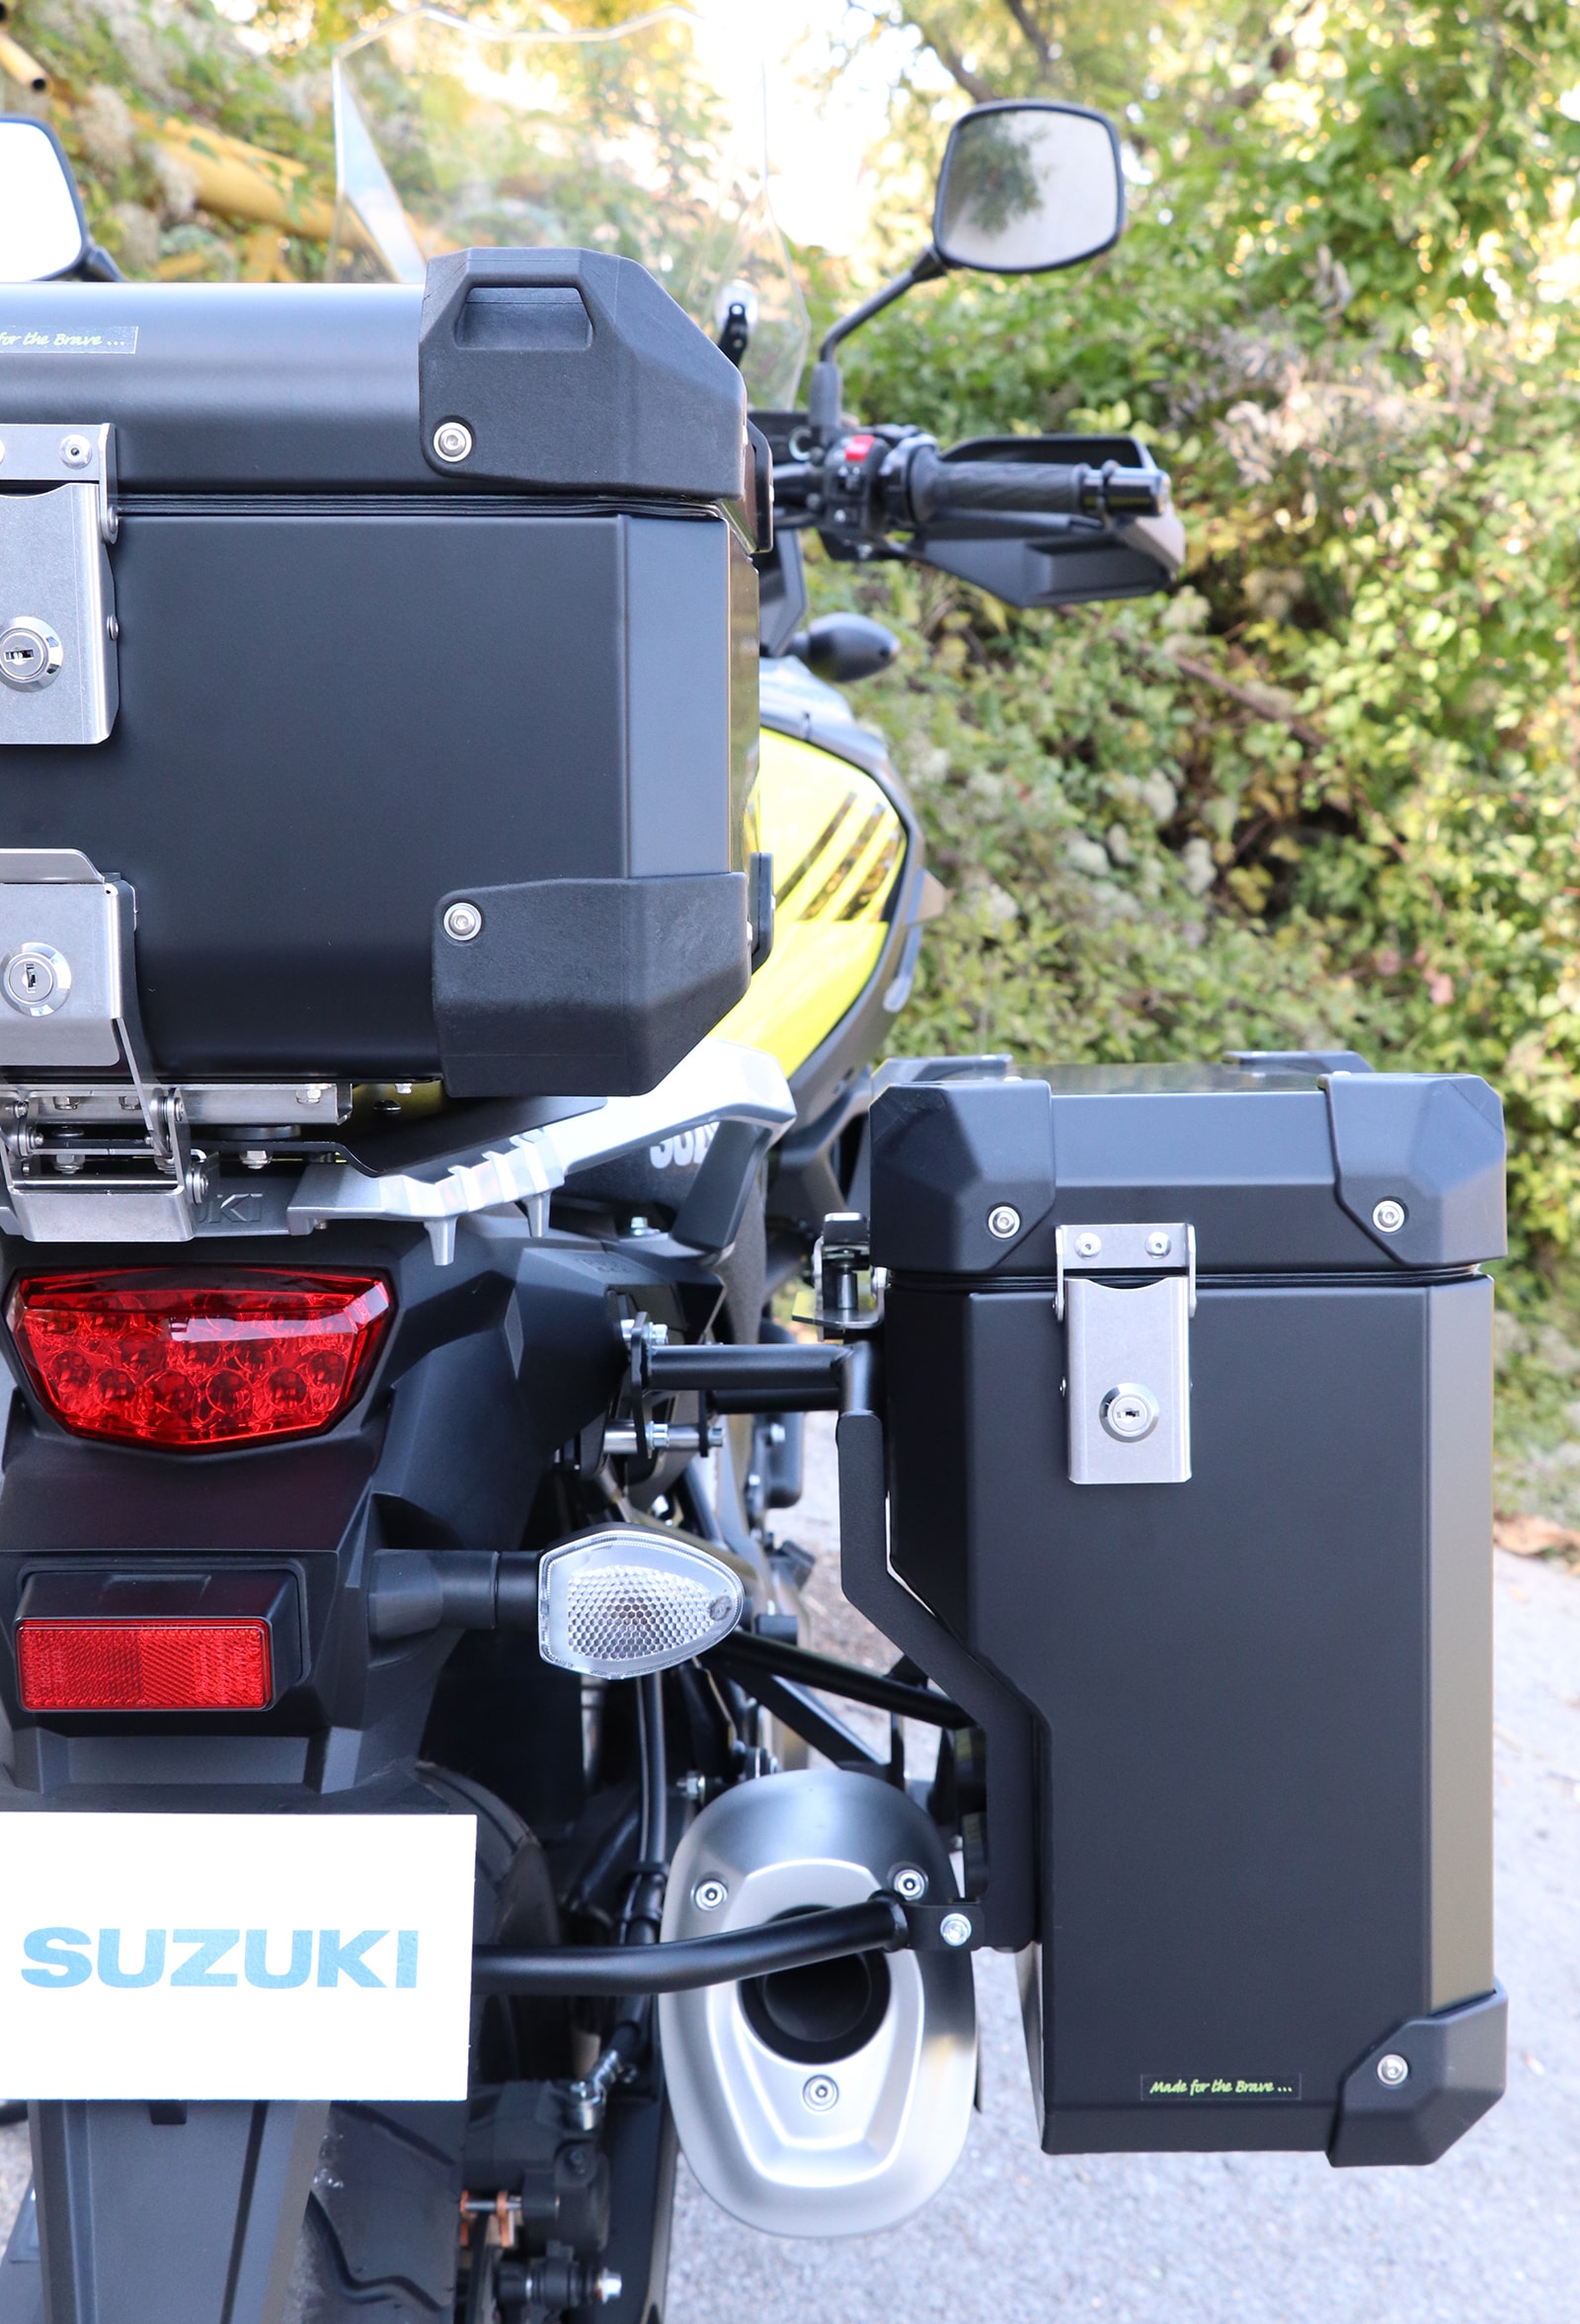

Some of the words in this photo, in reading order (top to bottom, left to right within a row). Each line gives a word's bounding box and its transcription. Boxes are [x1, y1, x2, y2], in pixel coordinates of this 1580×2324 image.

[23, 331, 49, 346] the
[53, 333, 103, 346] Brave
[21, 1926, 420, 1989] SUZUKI
[1149, 2079, 1187, 2094] Made
[1190, 2079, 1211, 2096] for
[1211, 2079, 1232, 2093] the
[1235, 2080, 1275, 2093] Brave
